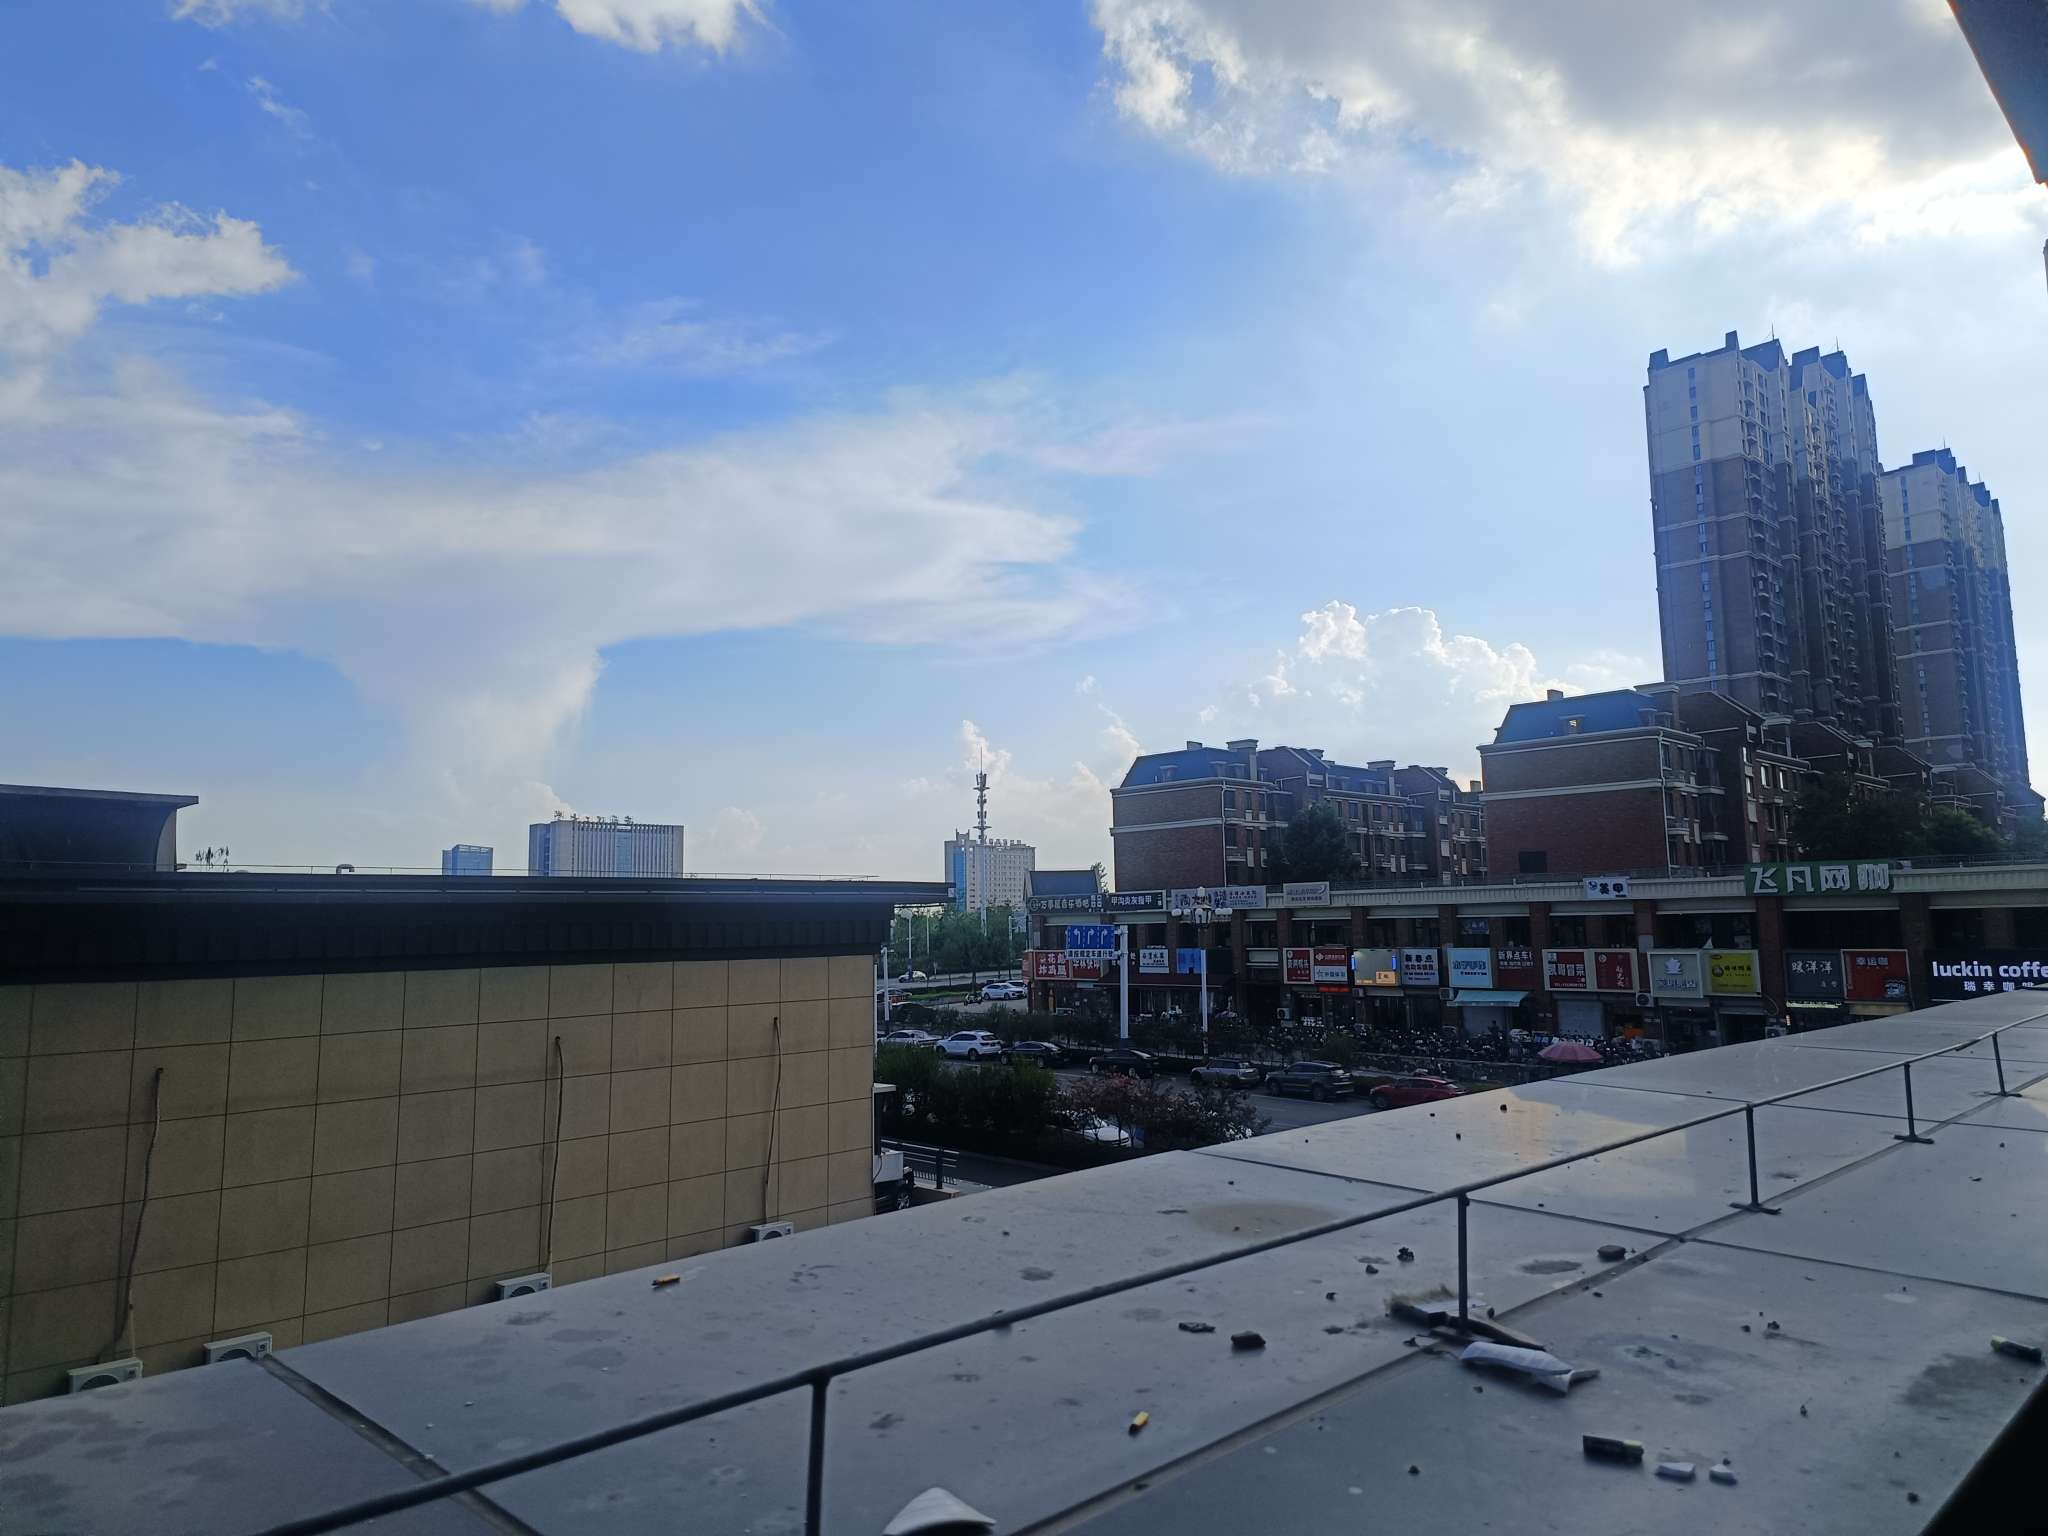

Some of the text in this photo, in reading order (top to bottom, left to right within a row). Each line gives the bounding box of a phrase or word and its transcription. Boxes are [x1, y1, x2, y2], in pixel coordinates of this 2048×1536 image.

[1750, 863, 1890, 893] 飞凡网咖
[1932, 961, 2048, 978] luckin coffe
